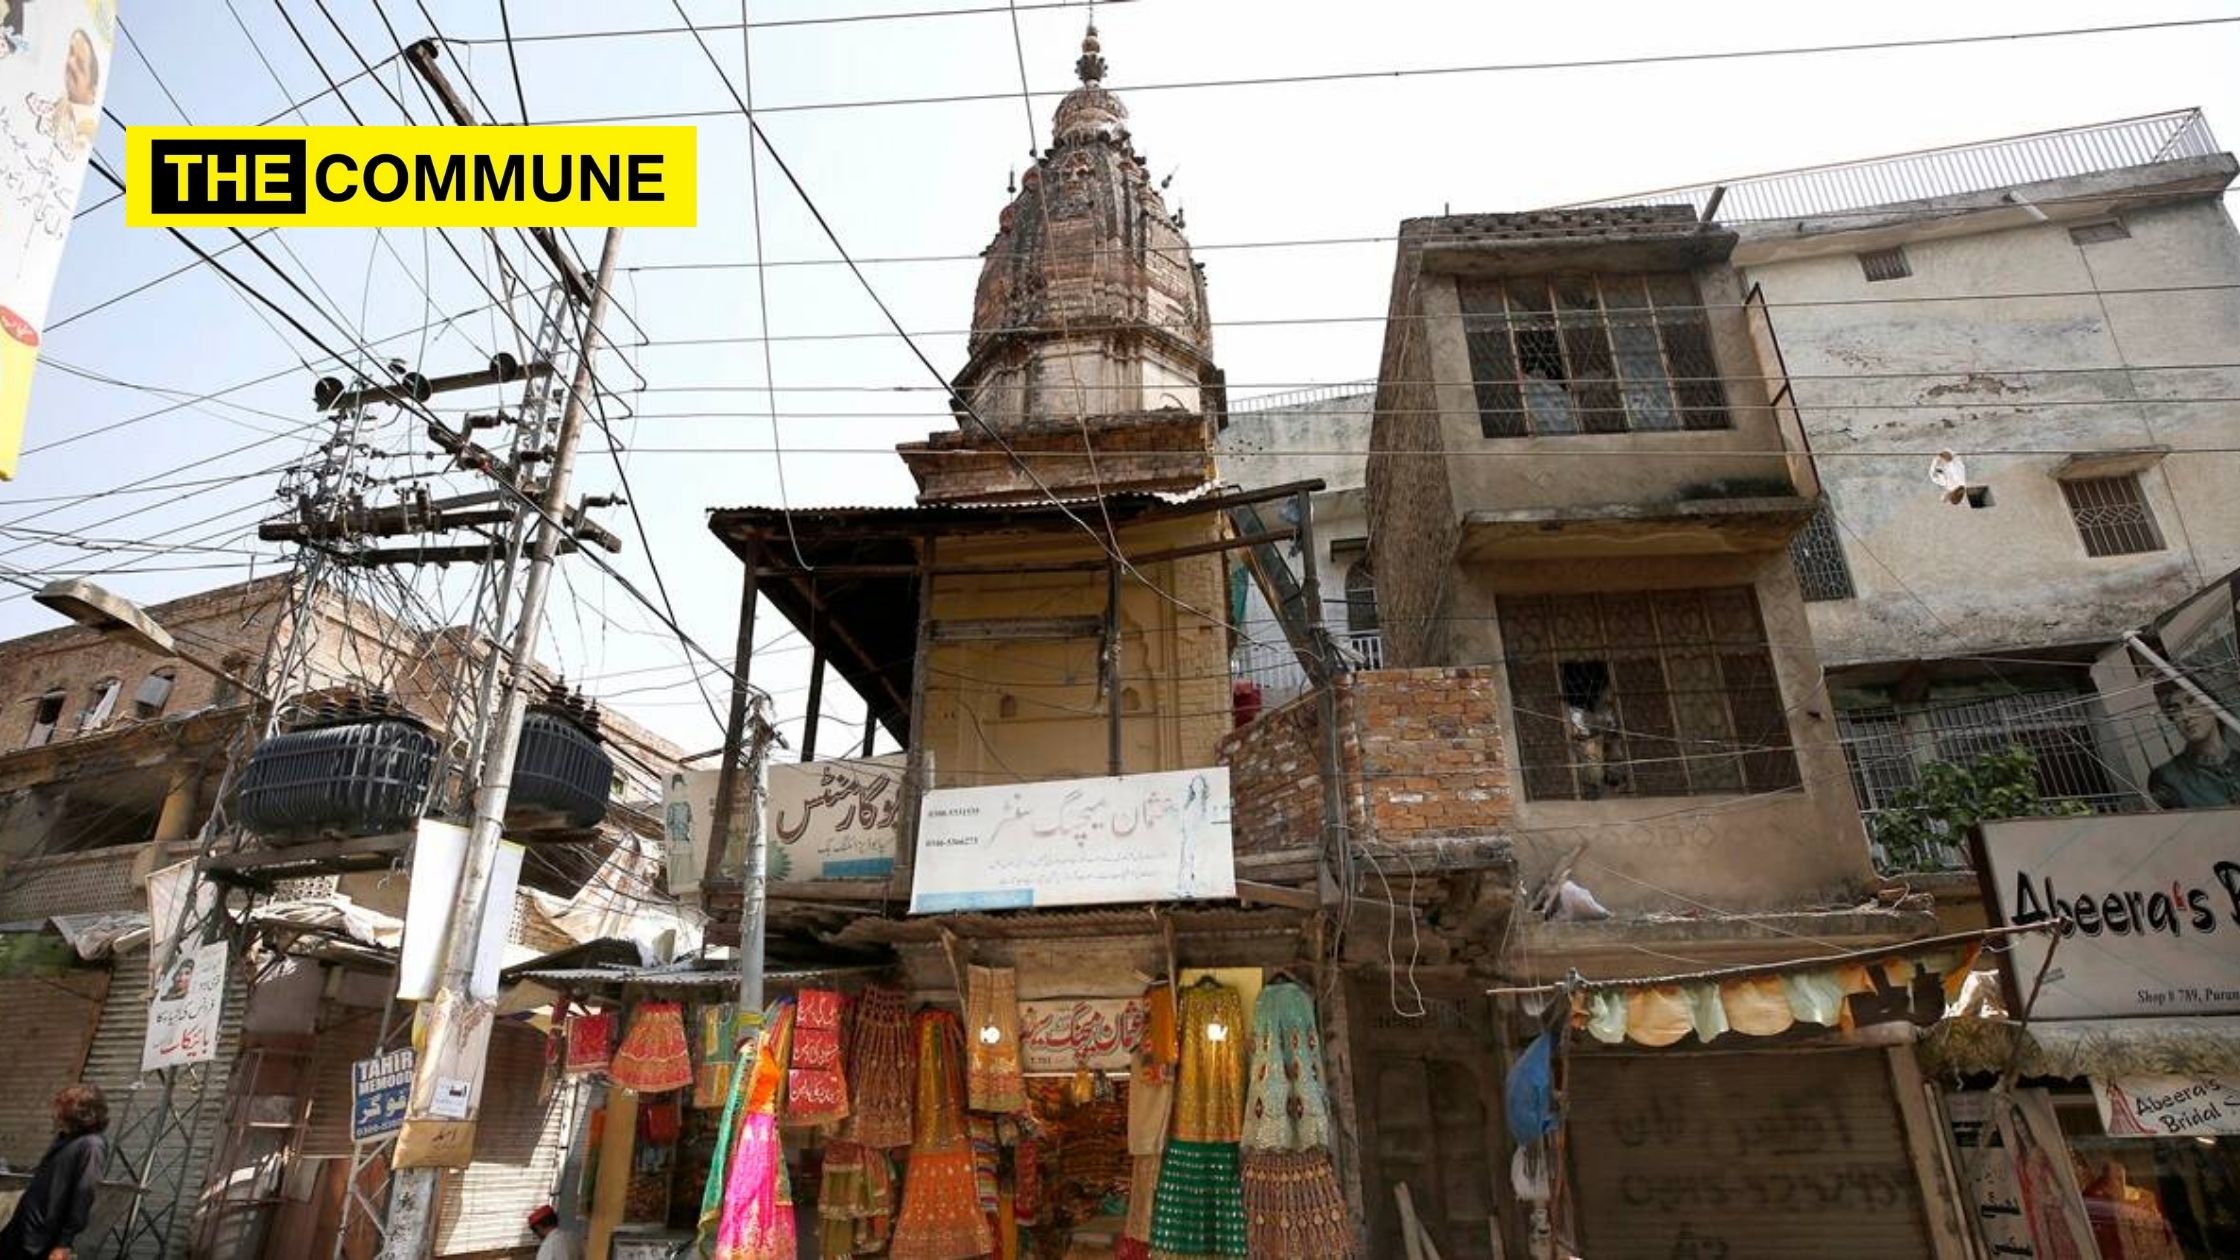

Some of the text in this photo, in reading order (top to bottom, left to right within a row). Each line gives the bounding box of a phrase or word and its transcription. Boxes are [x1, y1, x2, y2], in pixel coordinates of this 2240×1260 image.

[2011, 870, 2217, 938] Abeera's
[2138, 989, 2167, 1004] Shop
[358, 1050, 414, 1081] TAHIR
[2136, 1078, 2221, 1116] Abeera's
[2160, 1102, 2223, 1134] Bridal
